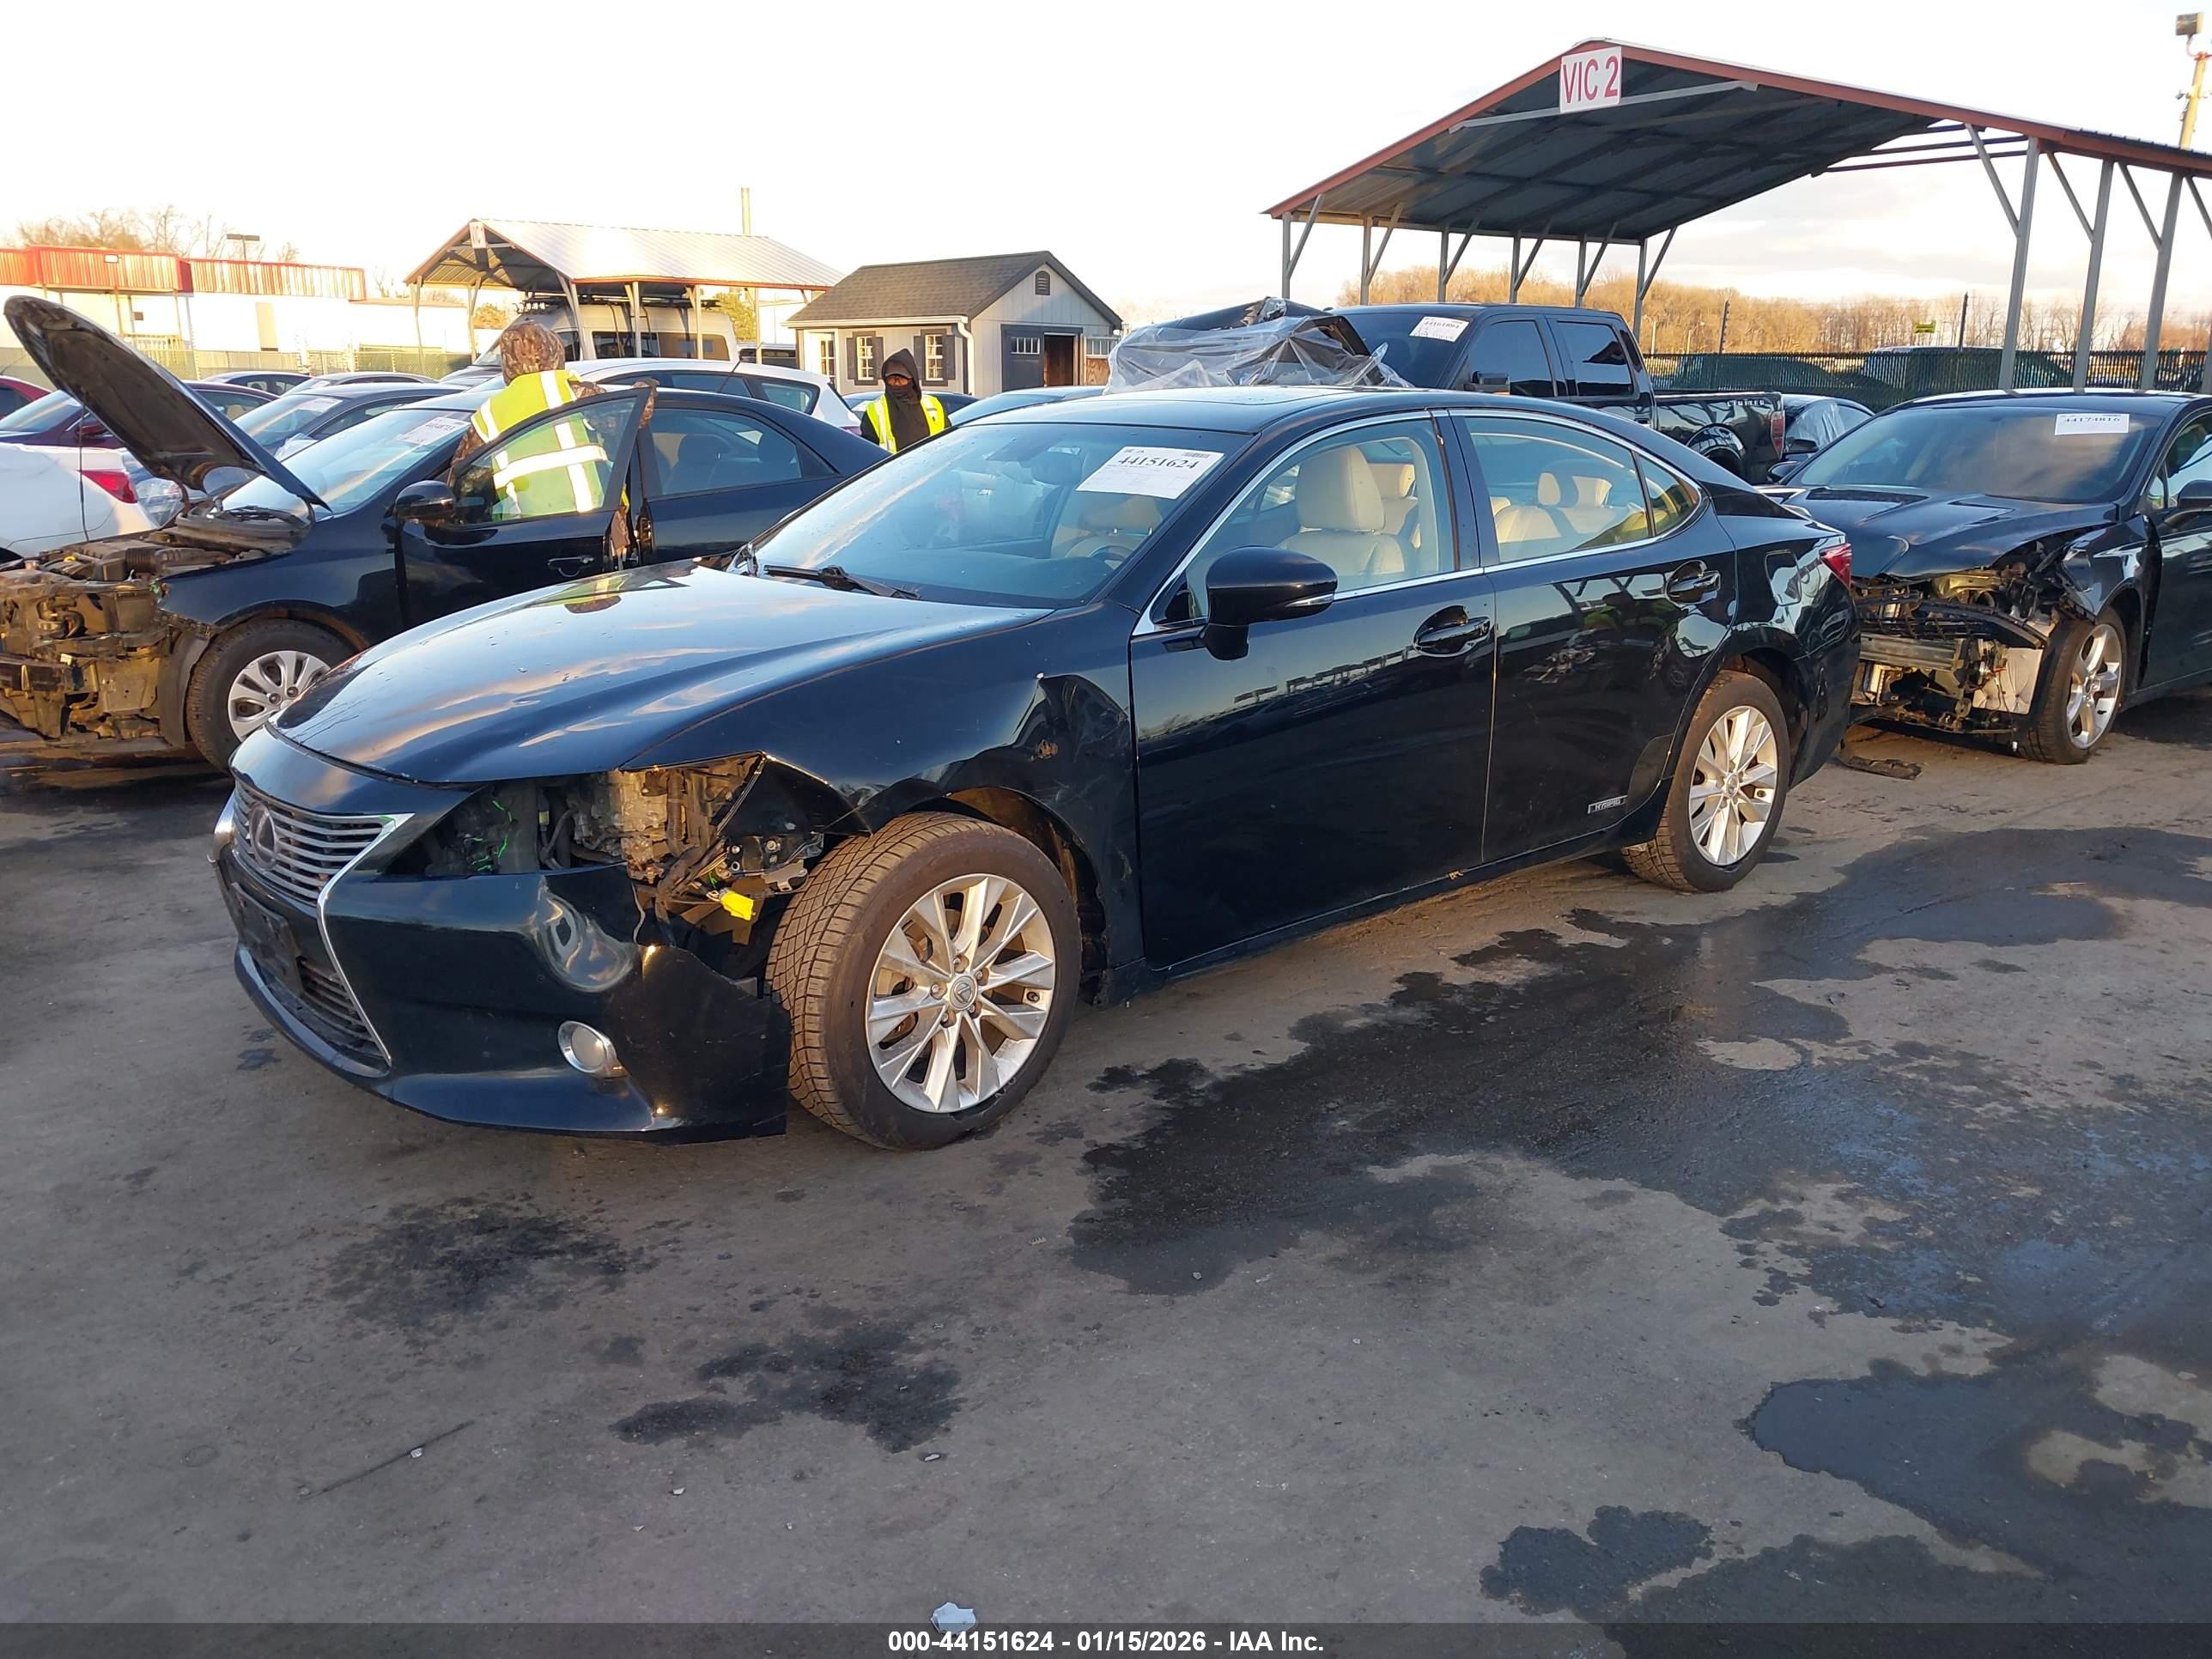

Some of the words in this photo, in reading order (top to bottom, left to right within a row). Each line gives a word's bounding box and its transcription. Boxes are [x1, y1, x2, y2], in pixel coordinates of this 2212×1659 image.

[1563, 58, 1598, 104] VIC
[1604, 55, 1619, 98] 2
[1118, 455, 1200, 469] 44151624
